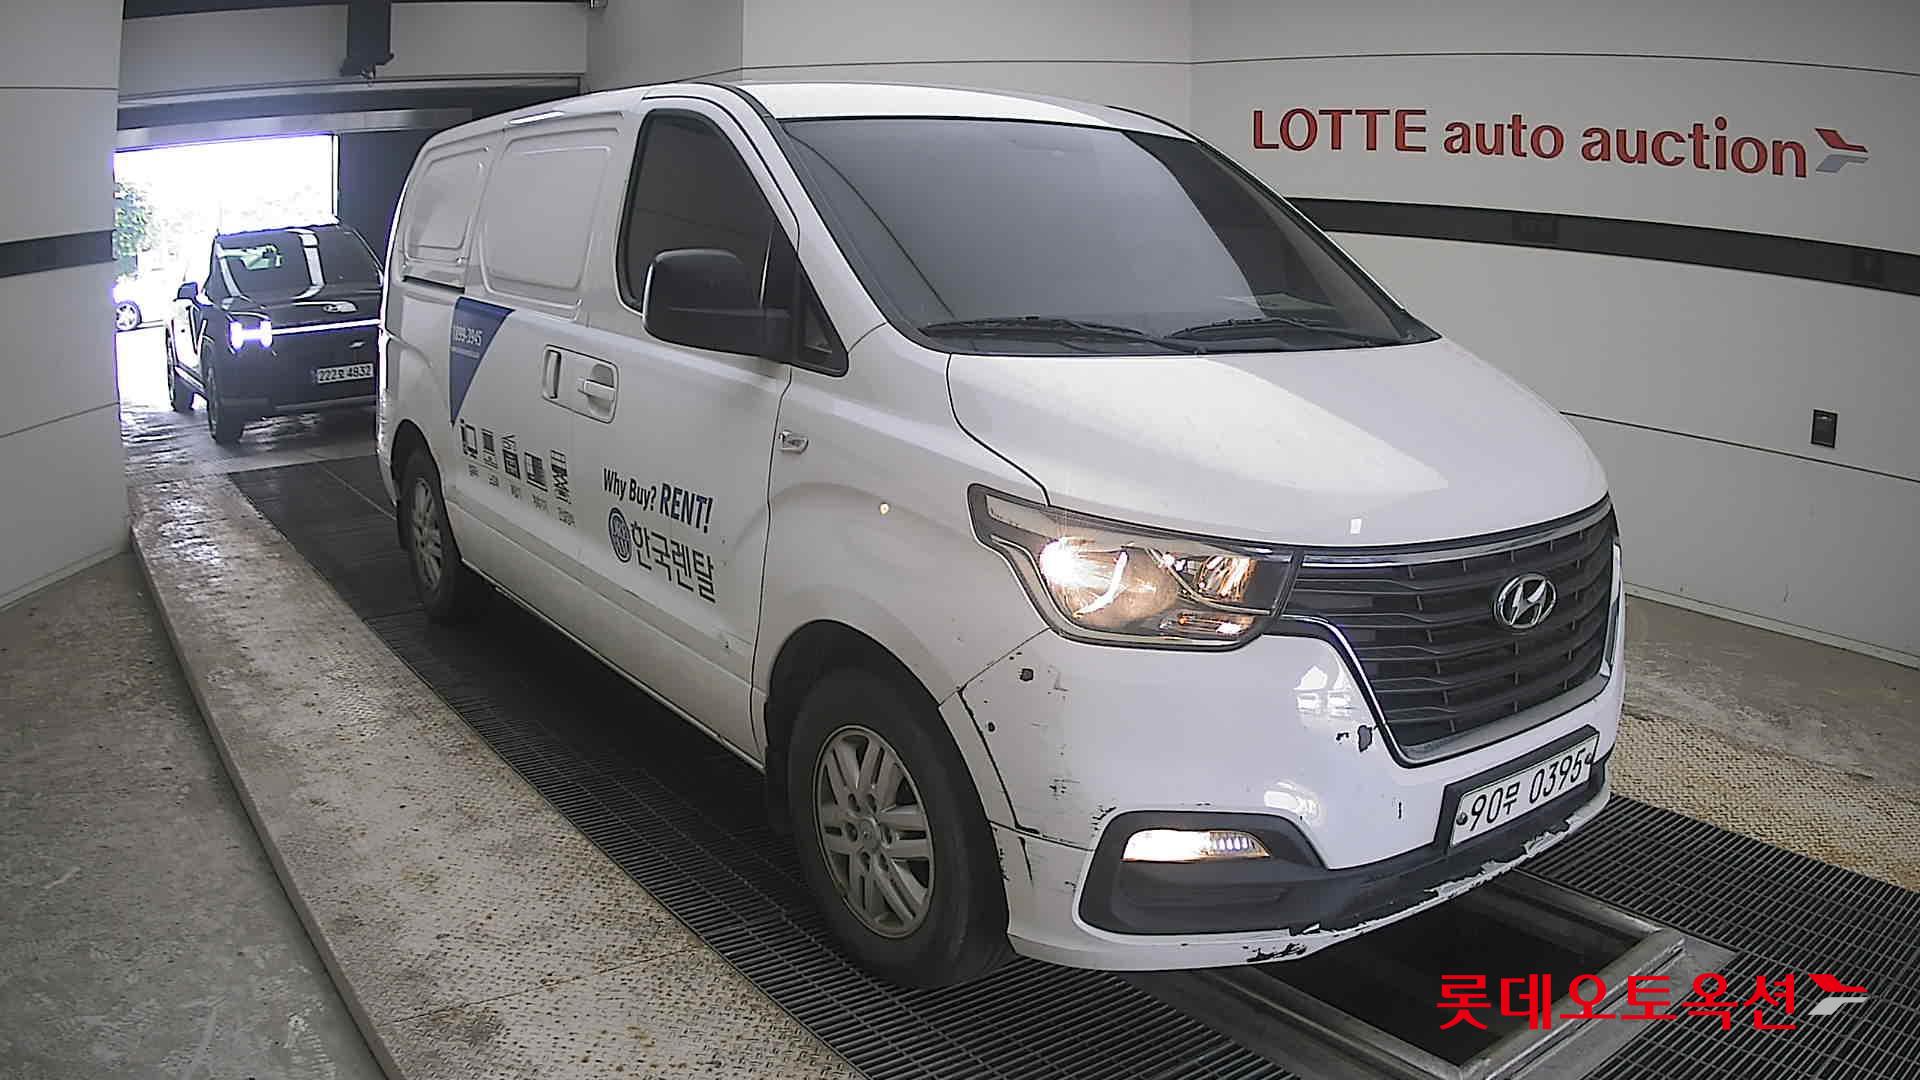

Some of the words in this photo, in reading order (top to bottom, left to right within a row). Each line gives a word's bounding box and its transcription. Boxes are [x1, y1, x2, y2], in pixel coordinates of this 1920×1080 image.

[1252, 108, 1427, 153] LOTTE
[1443, 114, 1565, 159] auto
[1581, 116, 1808, 178] auction
[603, 467, 627, 501] Why
[629, 478, 657, 511] Buy?
[660, 482, 713, 534] RENT!
[630, 520, 716, 604] 한국렌탈
[1529, 747, 1587, 804] 0395
